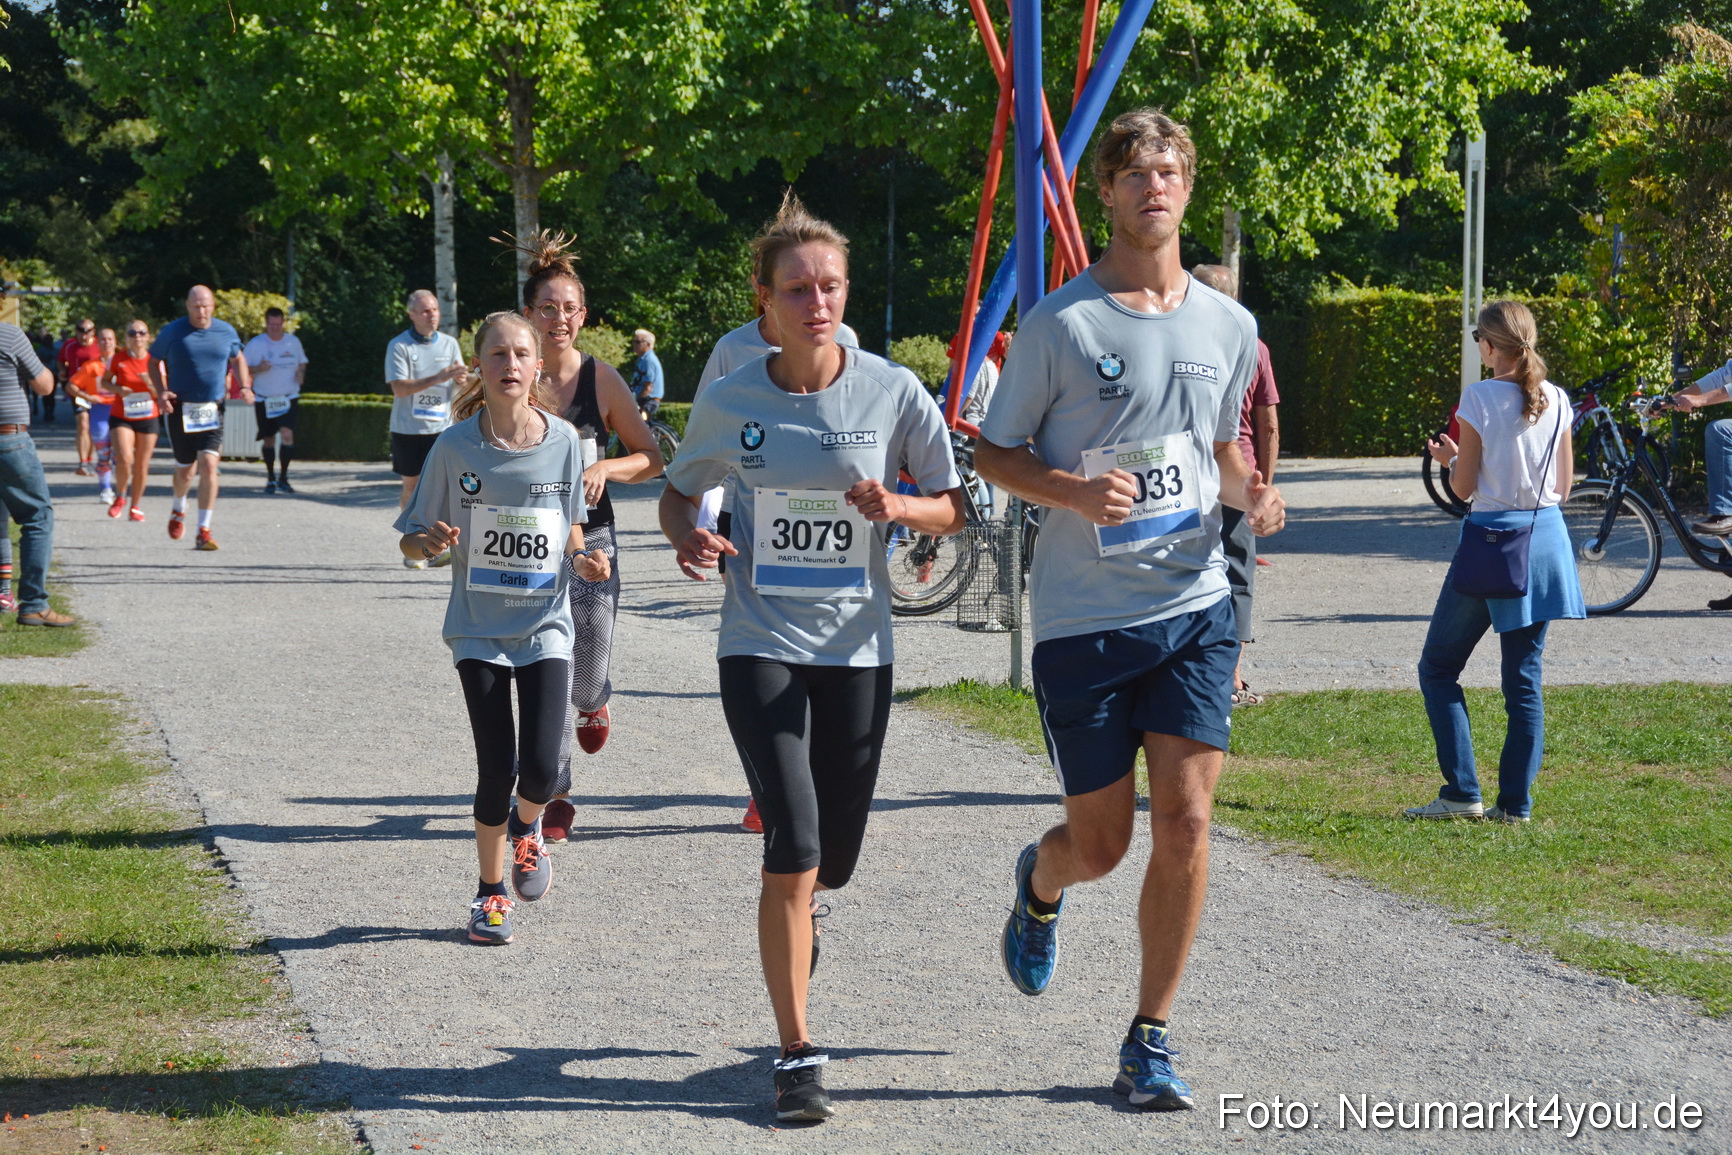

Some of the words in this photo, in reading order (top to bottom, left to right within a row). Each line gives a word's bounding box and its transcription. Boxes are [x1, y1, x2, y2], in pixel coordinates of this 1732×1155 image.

[1172, 361, 1218, 380] BOCK
[1099, 384, 1130, 396] PARTL
[418, 394, 442, 406] 2336
[1099, 392, 1130, 402] Neumarkt
[188, 408, 213, 420] 2380
[821, 431, 877, 446] BOCK
[741, 455, 765, 464] PARTL
[1116, 446, 1166, 465] BOCK
[530, 482, 572, 494] BOCK
[1130, 464, 1183, 504] 033
[788, 498, 838, 511] BOCK
[1143, 503, 1173, 515] Neumarkt
[497, 515, 537, 526] BOCK
[772, 518, 853, 551] 3079
[483, 530, 549, 560] 2068
[760, 541, 766, 549] C
[500, 573, 528, 586] Carla
[504, 597, 549, 607] Stadtlauf
